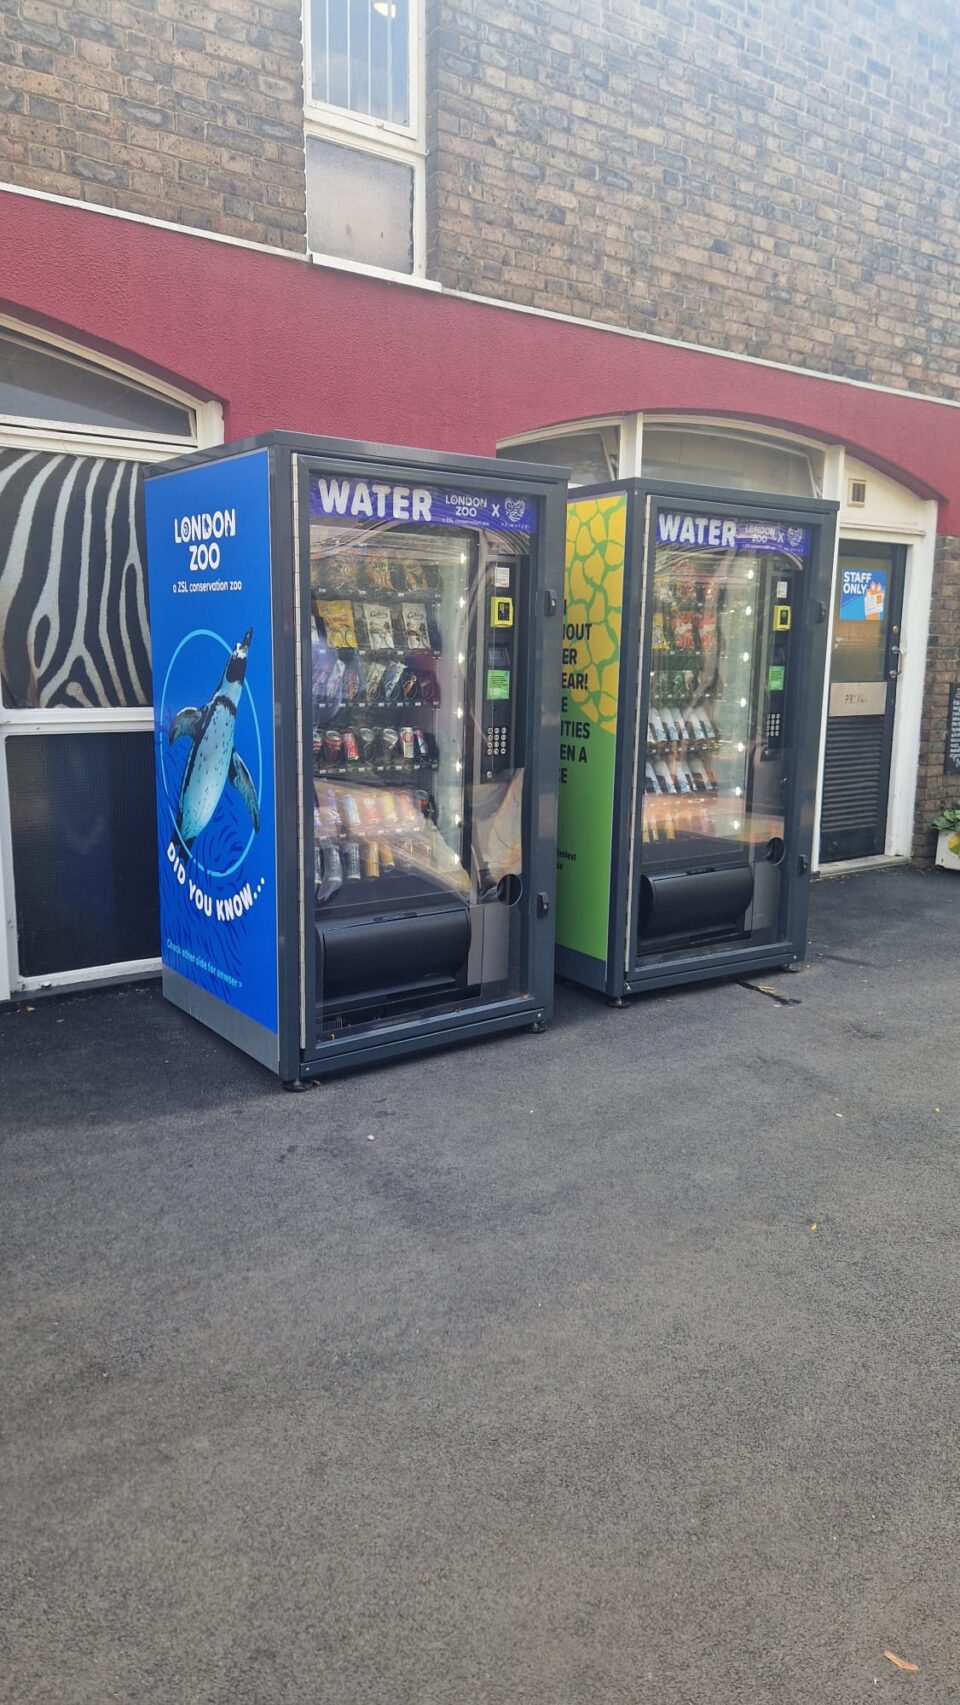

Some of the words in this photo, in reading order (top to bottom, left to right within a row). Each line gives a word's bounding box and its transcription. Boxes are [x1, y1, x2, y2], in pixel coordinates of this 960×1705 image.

[318, 478, 433, 522] WATER
[445, 494, 488, 508] LONDON
[491, 503, 500, 518] X
[455, 506, 477, 517] ZOO
[174, 508, 236, 544] LONDON
[658, 513, 737, 547] WATER
[745, 524, 776, 535] LONDON
[752, 533, 768, 543] ZOO
[189, 542, 221, 571] ZOO
[172, 584, 177, 593] a
[177, 580, 189, 593] ZSL
[189, 578, 228, 592] conservation
[229, 580, 242, 591] zoo
[843, 571, 872, 583] STAFF
[843, 582, 868, 595] ONLY
[562, 648, 577, 665] ER
[561, 672, 588, 690] EAR!
[578, 746, 588, 763] A
[559, 767, 568, 784] E
[167, 841, 186, 885] DID
[188, 879, 212, 917] YOU
[166, 938, 181, 954] Check
[181, 949, 195, 963] other
[195, 955, 207, 970] side
[207, 961, 216, 976] for
